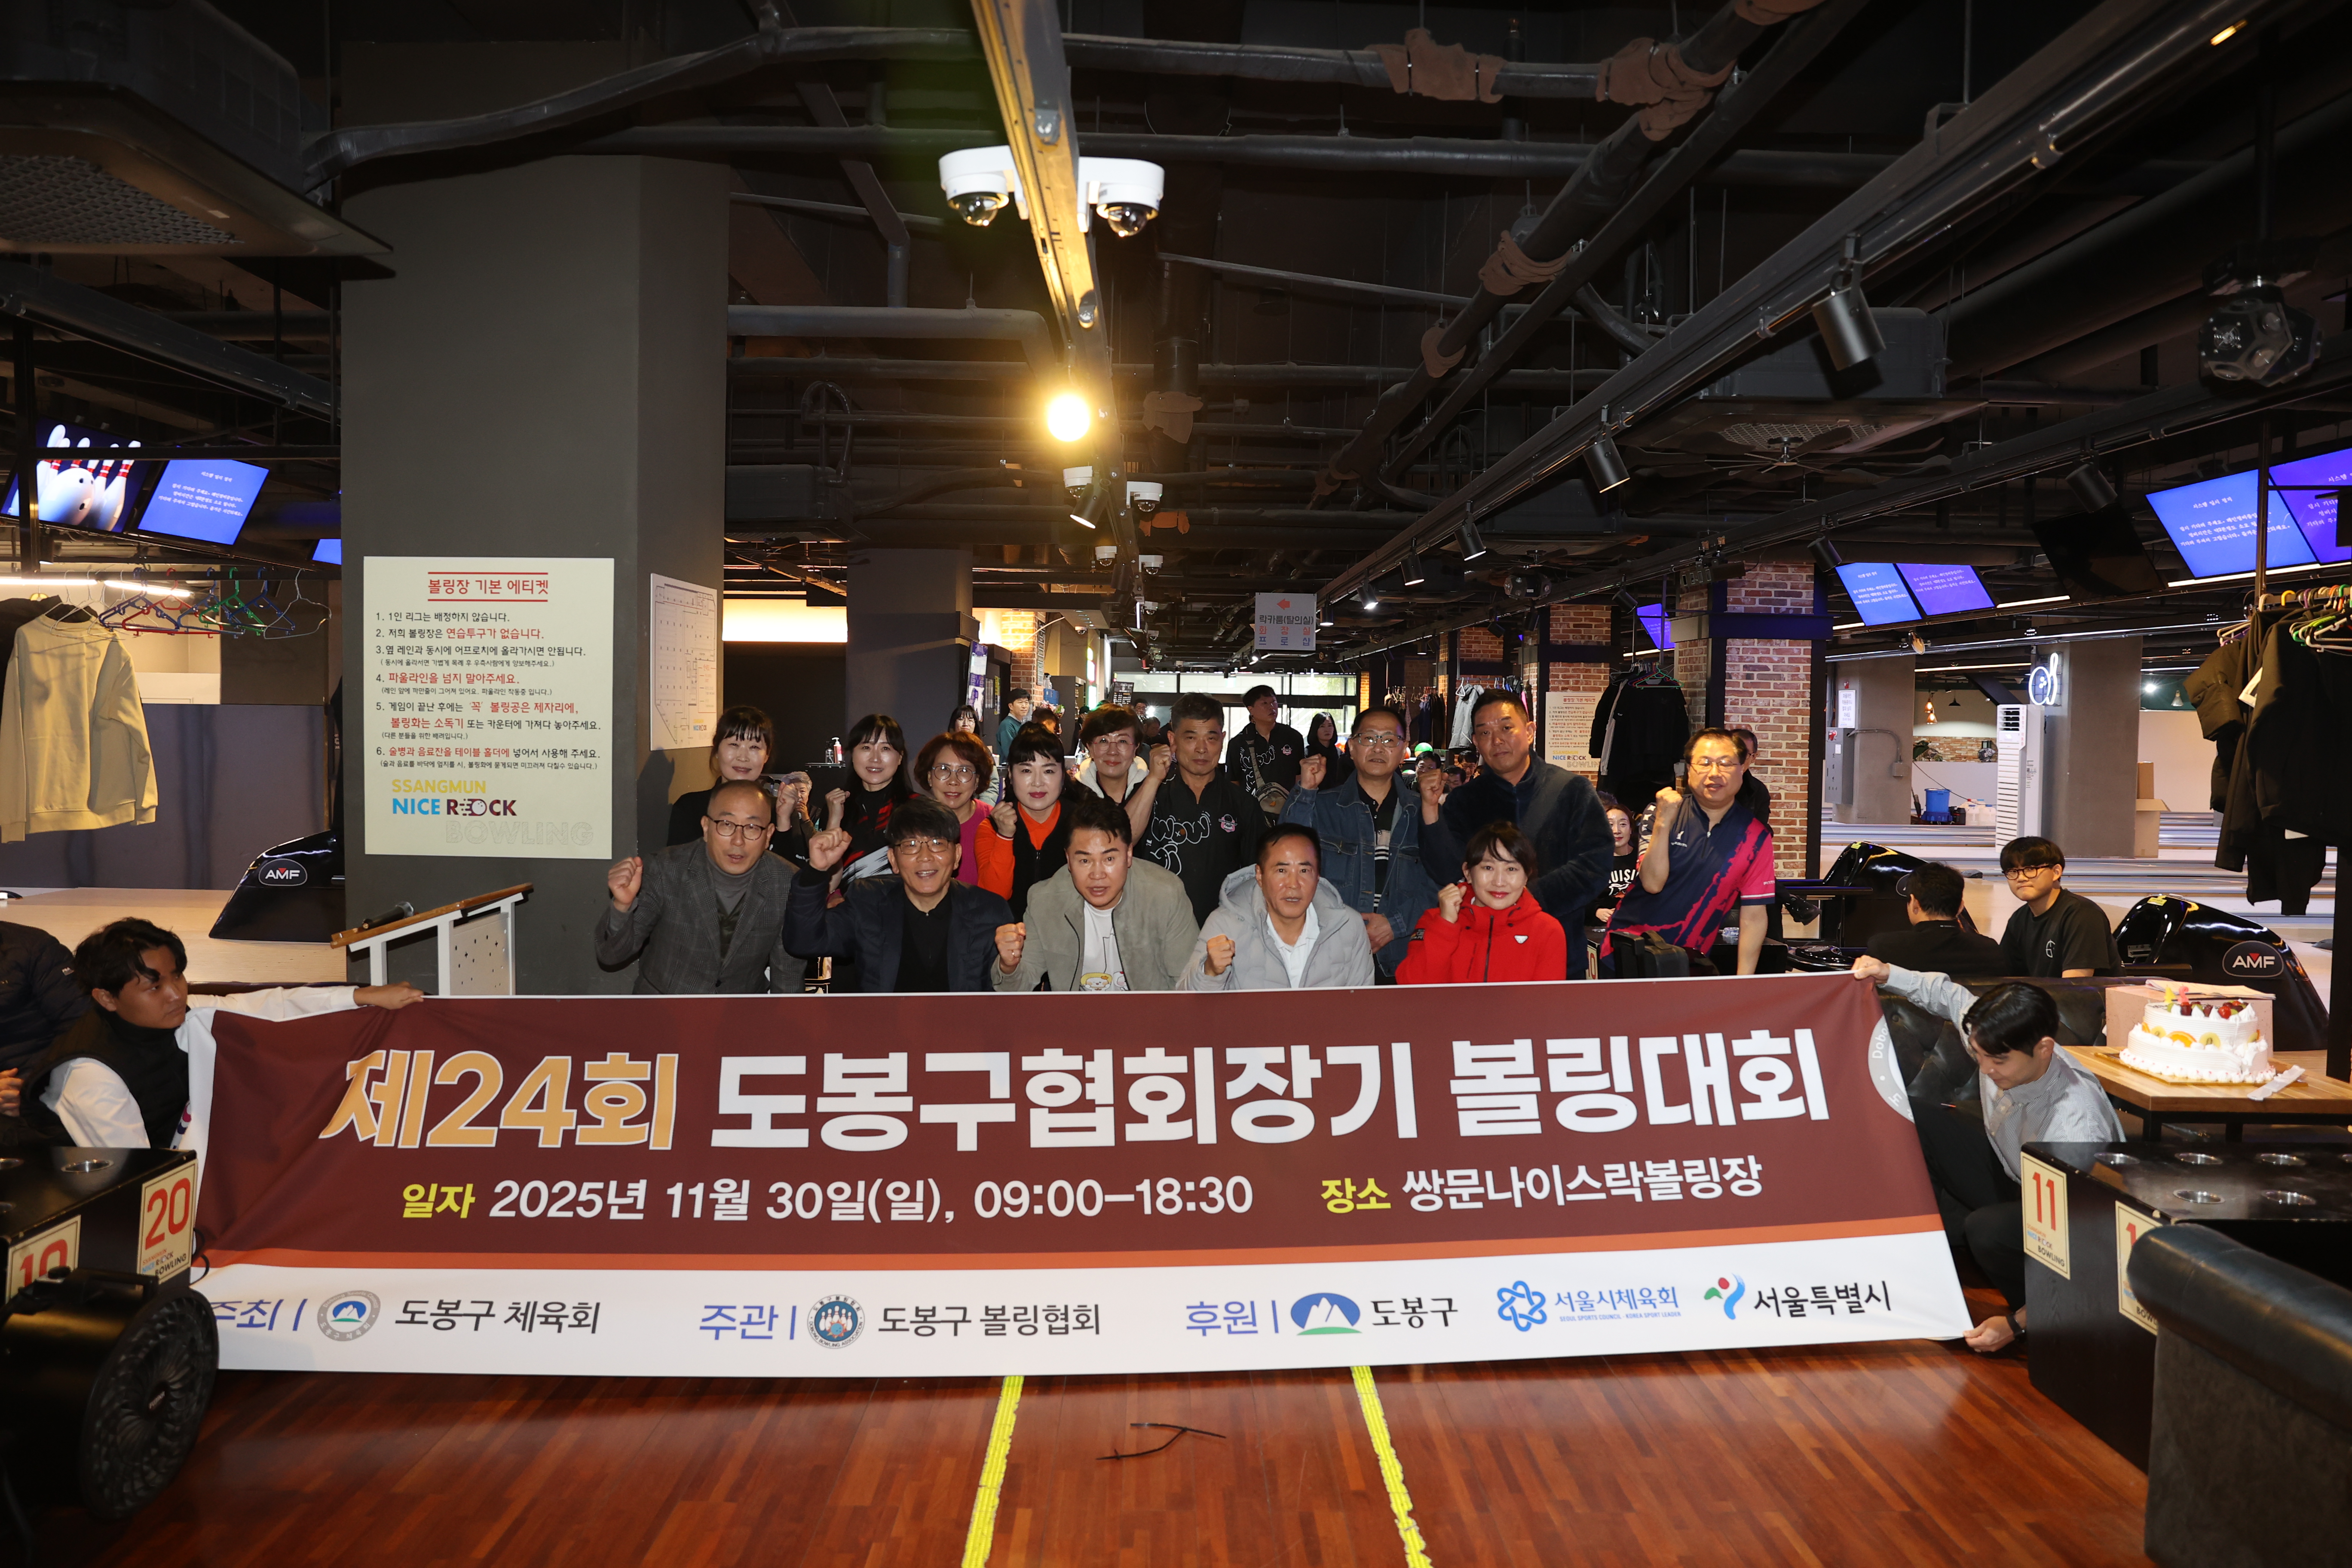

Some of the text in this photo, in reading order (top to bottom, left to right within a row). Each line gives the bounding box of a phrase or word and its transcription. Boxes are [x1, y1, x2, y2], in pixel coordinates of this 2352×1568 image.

[428, 579, 548, 594] 볼링장 기본 에티켓
[376, 612, 510, 622] 1. 1인 리그는 배정하지 않습니다.
[1259, 615, 1314, 625] 락카룸(탈의실)
[376, 628, 544, 640] 2. 저희 볼링장은 연습투구가 없습니다.
[397, 645, 423, 655] 레인과
[426, 646, 452, 655] 동시에
[455, 646, 498, 655] 어프로치에
[501, 646, 544, 656] 올라가시면
[547, 646, 586, 656] 안됩니다.
[376, 672, 520, 684] 4. 파울라인을 넘지 말아주세요.
[376, 702, 385, 711] 5.
[388, 702, 414, 712] 게임이
[417, 702, 435, 712] 끝난
[437, 702, 463, 712] 후에는
[490, 702, 530, 714] 볼링공은
[534, 702, 578, 714] 제자리에,
[390, 717, 601, 730] 볼링화는 소독기 또는 카운터에 가져다 놓아주세요.
[376, 747, 600, 759] 6. 술병과 음료잔을 테이블 홀더에 넣어서 사용해 주세요.
[392, 779, 486, 793] SSANGMUN
[392, 798, 518, 817] NICE ROCK
[446, 820, 594, 846] BOWLING
[265, 869, 300, 879] AMF
[2232, 954, 2275, 969] AMF
[318, 1028, 1829, 1152] 제24회 도봉구협회장기 볼링대회
[1320, 1155, 1763, 1214] 장소 쌍문나이스락볼링장
[402, 1183, 476, 1219] 일자
[489, 1179, 648, 1220] 2025년
[666, 1178, 750, 1221] 11월
[766, 1177, 955, 1224] 30일(일),
[2033, 1172, 2056, 1231] 11
[145, 1178, 191, 1250] 20
[155, 1253, 187, 1277] BOWLING
[2038, 1245, 2065, 1267] BOWLING
[1554, 1286, 1679, 1312] 서울시체육회
[1753, 1280, 1892, 1318] 서울특별시
[395, 1299, 600, 1334] 도봉구 체육회
[699, 1305, 779, 1340] 주관
[878, 1304, 1100, 1337] 도봉구 볼링협회
[1186, 1301, 1259, 1336] 후원
[1370, 1297, 1458, 1329] 도봉구
[819, 1338, 840, 1347] BOWLING
[842, 1322, 864, 1346] ASSOCIATION
